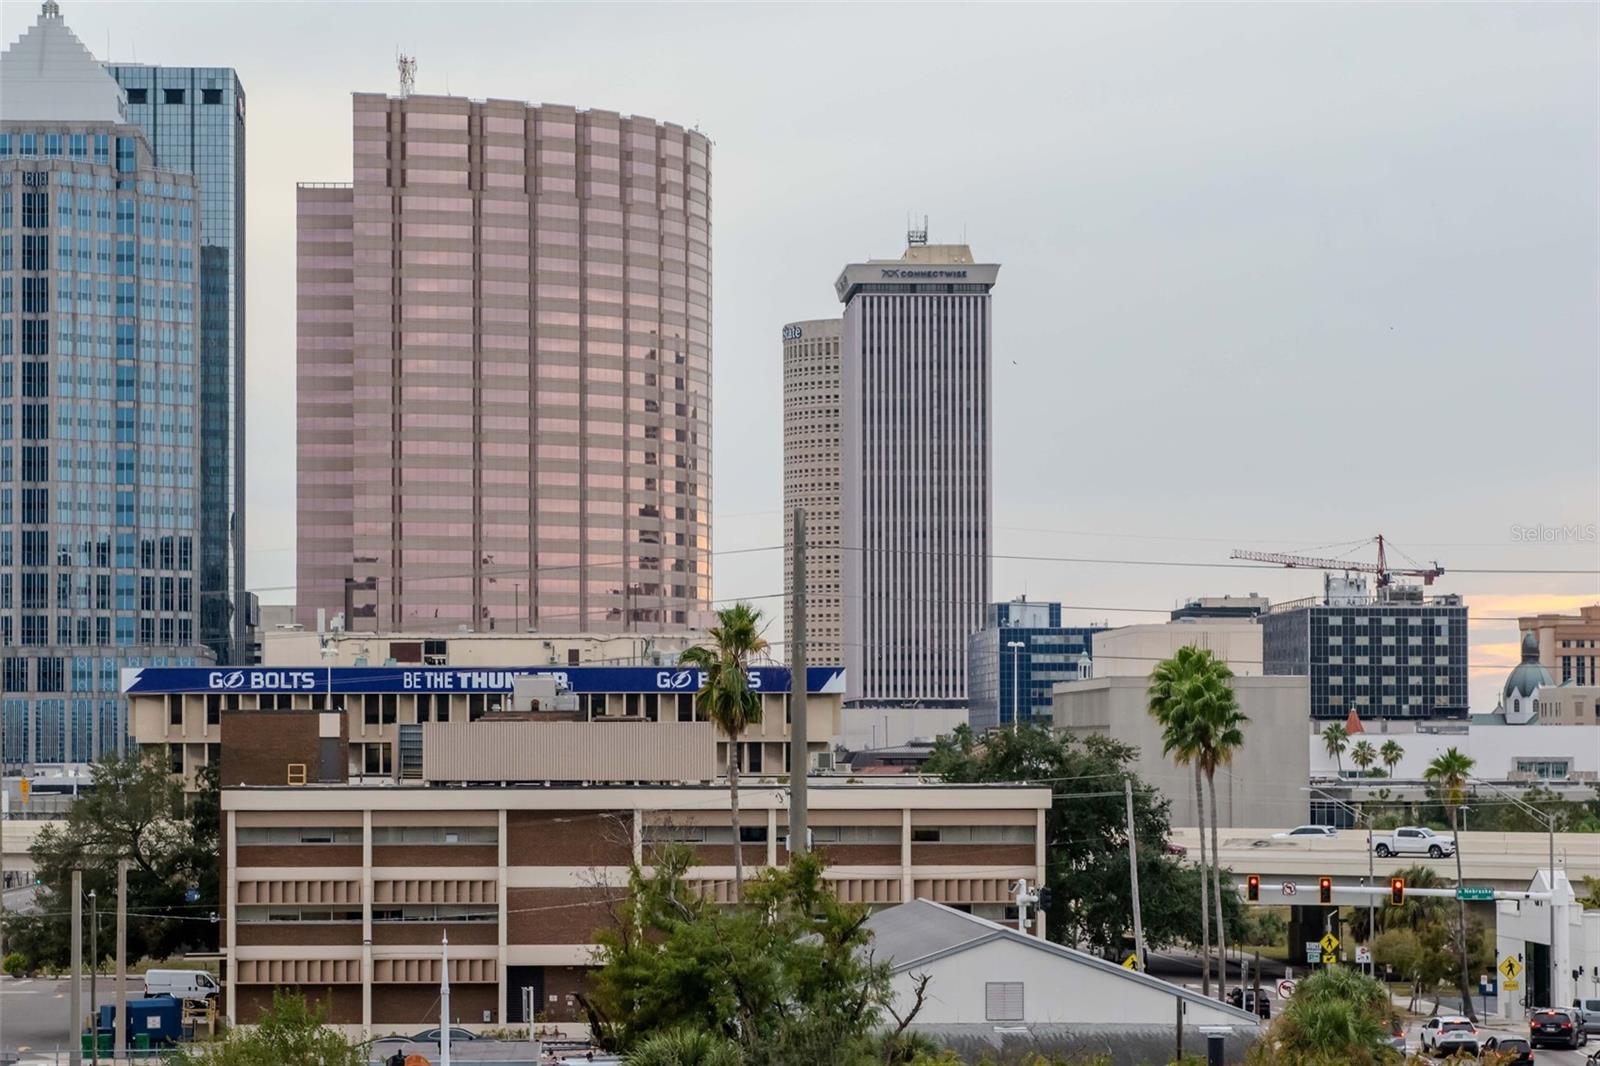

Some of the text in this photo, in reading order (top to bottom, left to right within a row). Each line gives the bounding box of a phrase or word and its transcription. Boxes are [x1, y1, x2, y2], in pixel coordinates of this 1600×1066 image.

[900, 270, 968, 278] CONNECTWISE
[250, 672, 315, 689] BOLTS
[403, 672, 569, 689] BE THE THUNR
